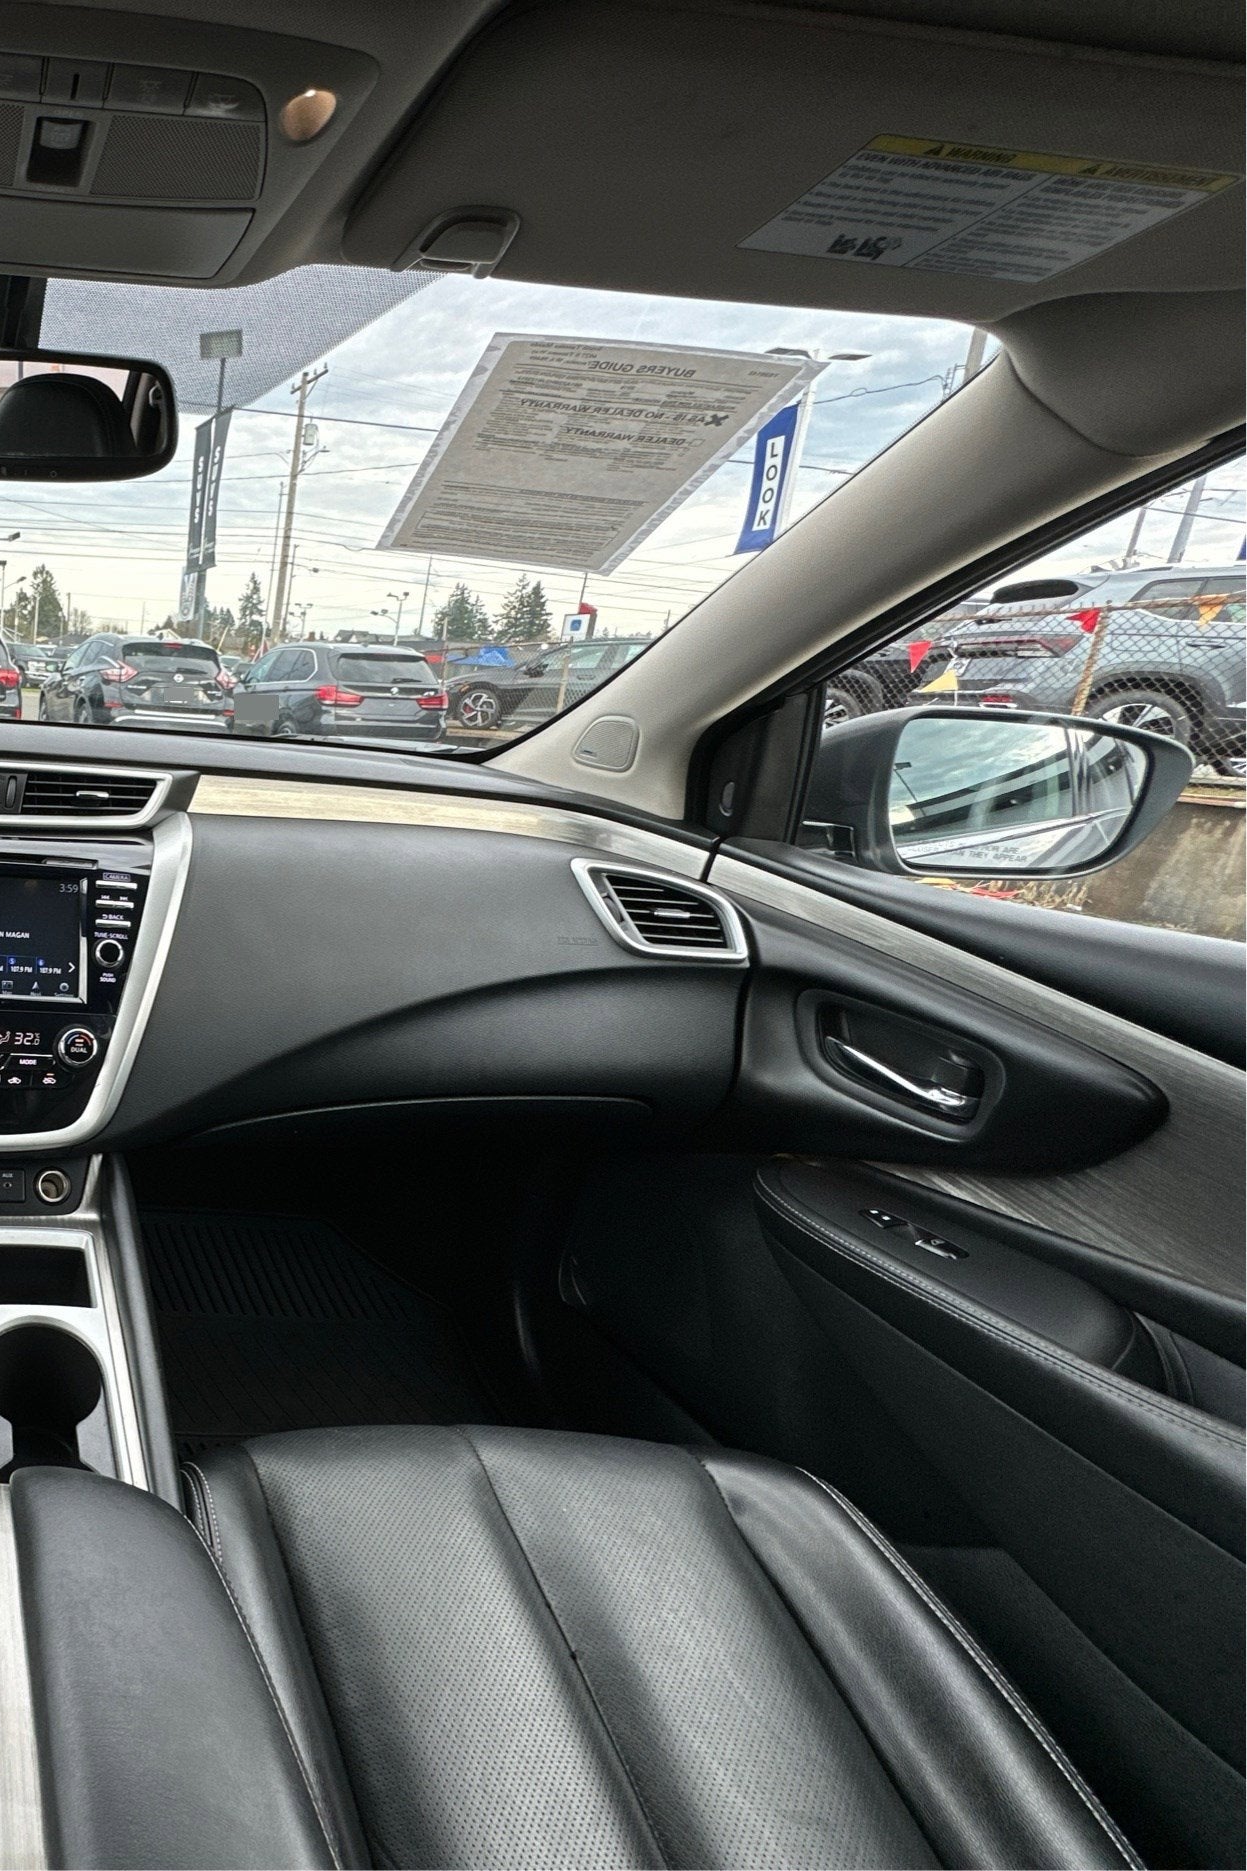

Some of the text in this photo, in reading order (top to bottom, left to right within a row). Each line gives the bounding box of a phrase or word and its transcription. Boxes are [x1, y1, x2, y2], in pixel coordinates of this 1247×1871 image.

[757, 442, 779, 527] LOOK
[1001, 846, 1021, 854] ARE
[968, 850, 989, 858] THEY
[992, 853, 1028, 863] APPEAR
[59, 884, 79, 893] 3:59
[5, 931, 30, 939] MAGAN
